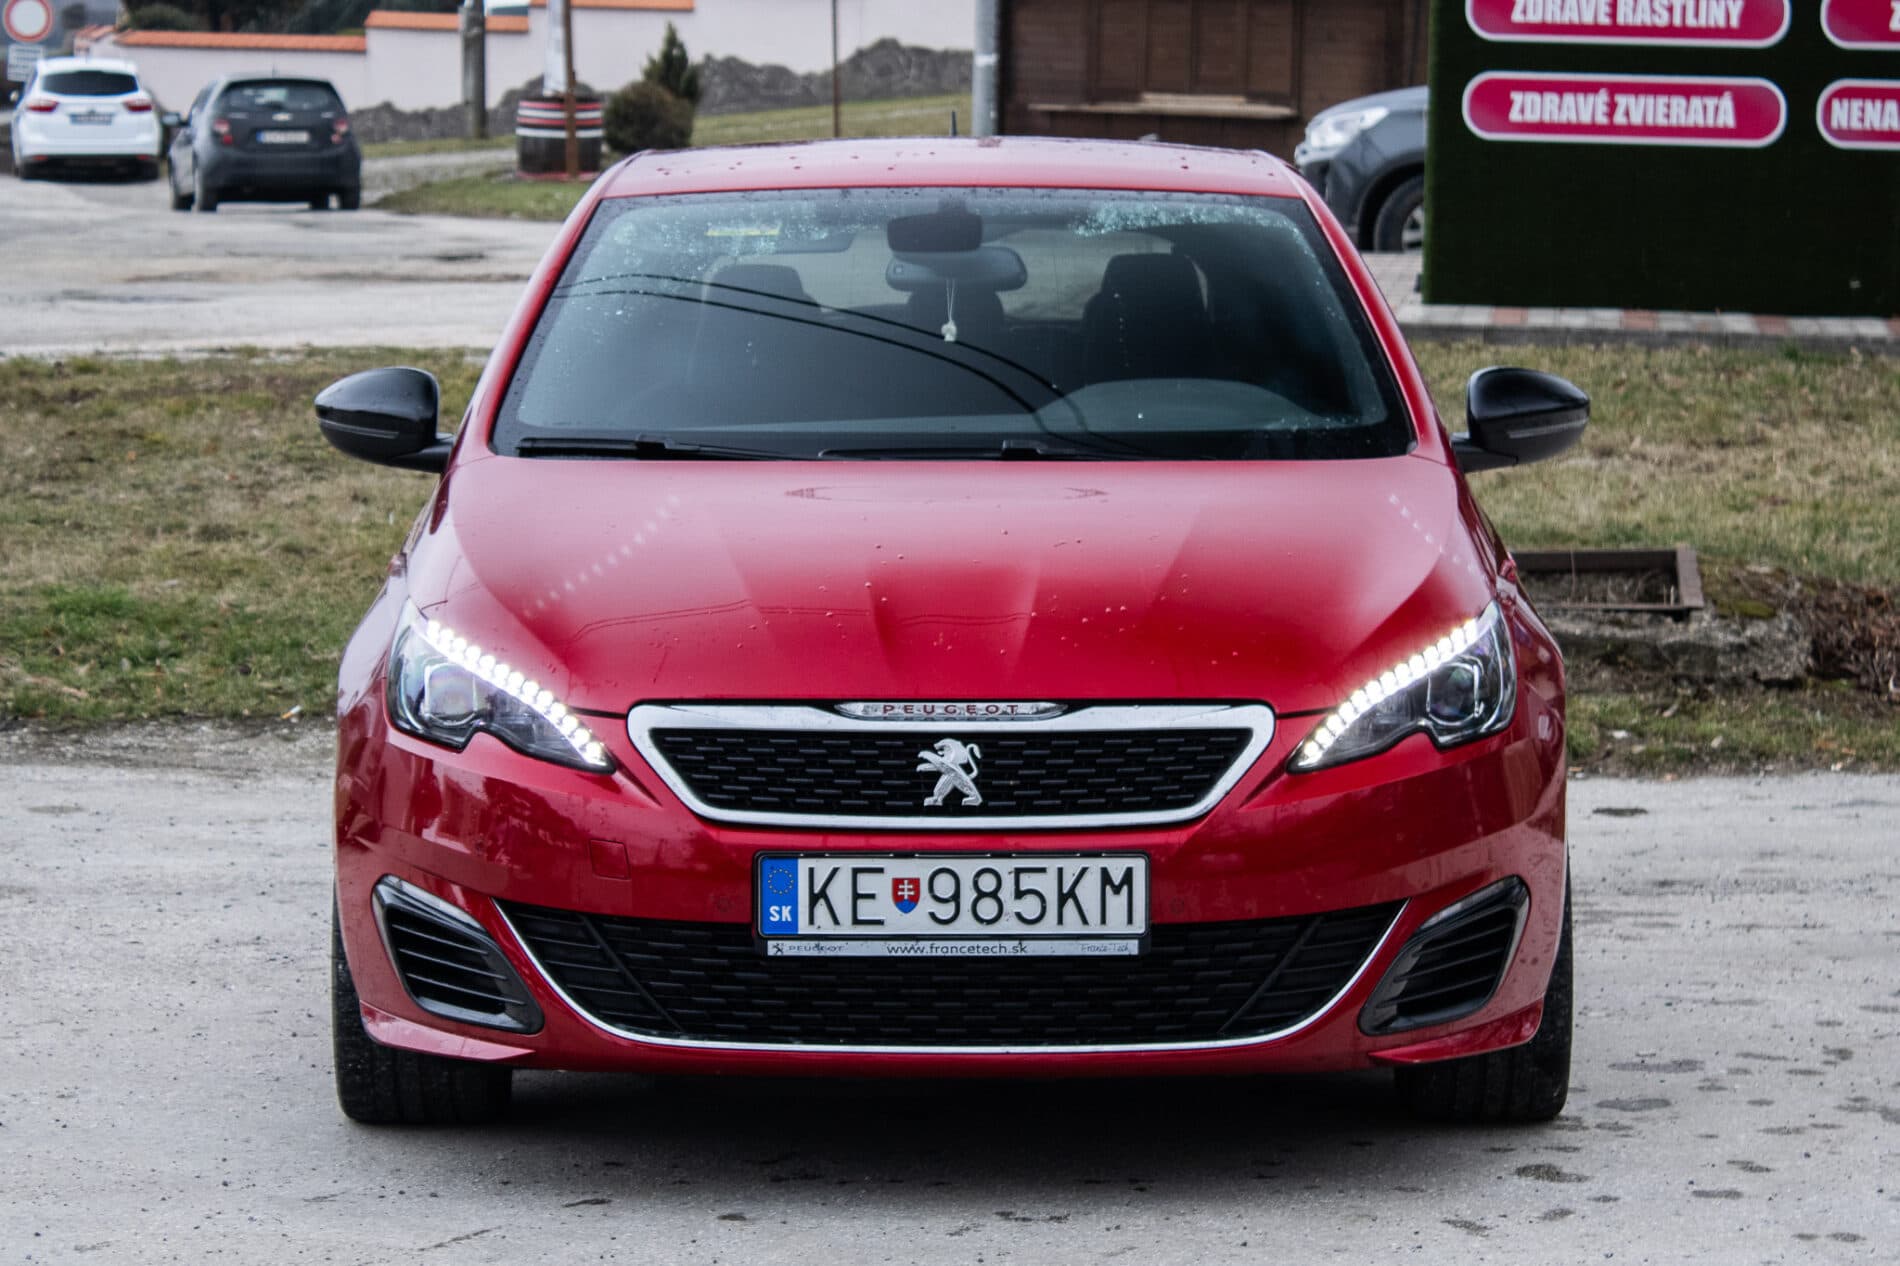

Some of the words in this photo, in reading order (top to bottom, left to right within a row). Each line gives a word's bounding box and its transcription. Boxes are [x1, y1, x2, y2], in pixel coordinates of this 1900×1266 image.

[1615, 0, 1744, 28] RASTLINY
[1508, 89, 1609, 125] ZDRAVÉ
[1612, 91, 1737, 129] ZVIERATÁ
[882, 704, 1019, 715] PEUGEOT
[807, 866, 886, 926] KE
[926, 866, 1135, 926] 985KM
[769, 905, 793, 922] SK
[886, 942, 1028, 955] www.francetech.sk
